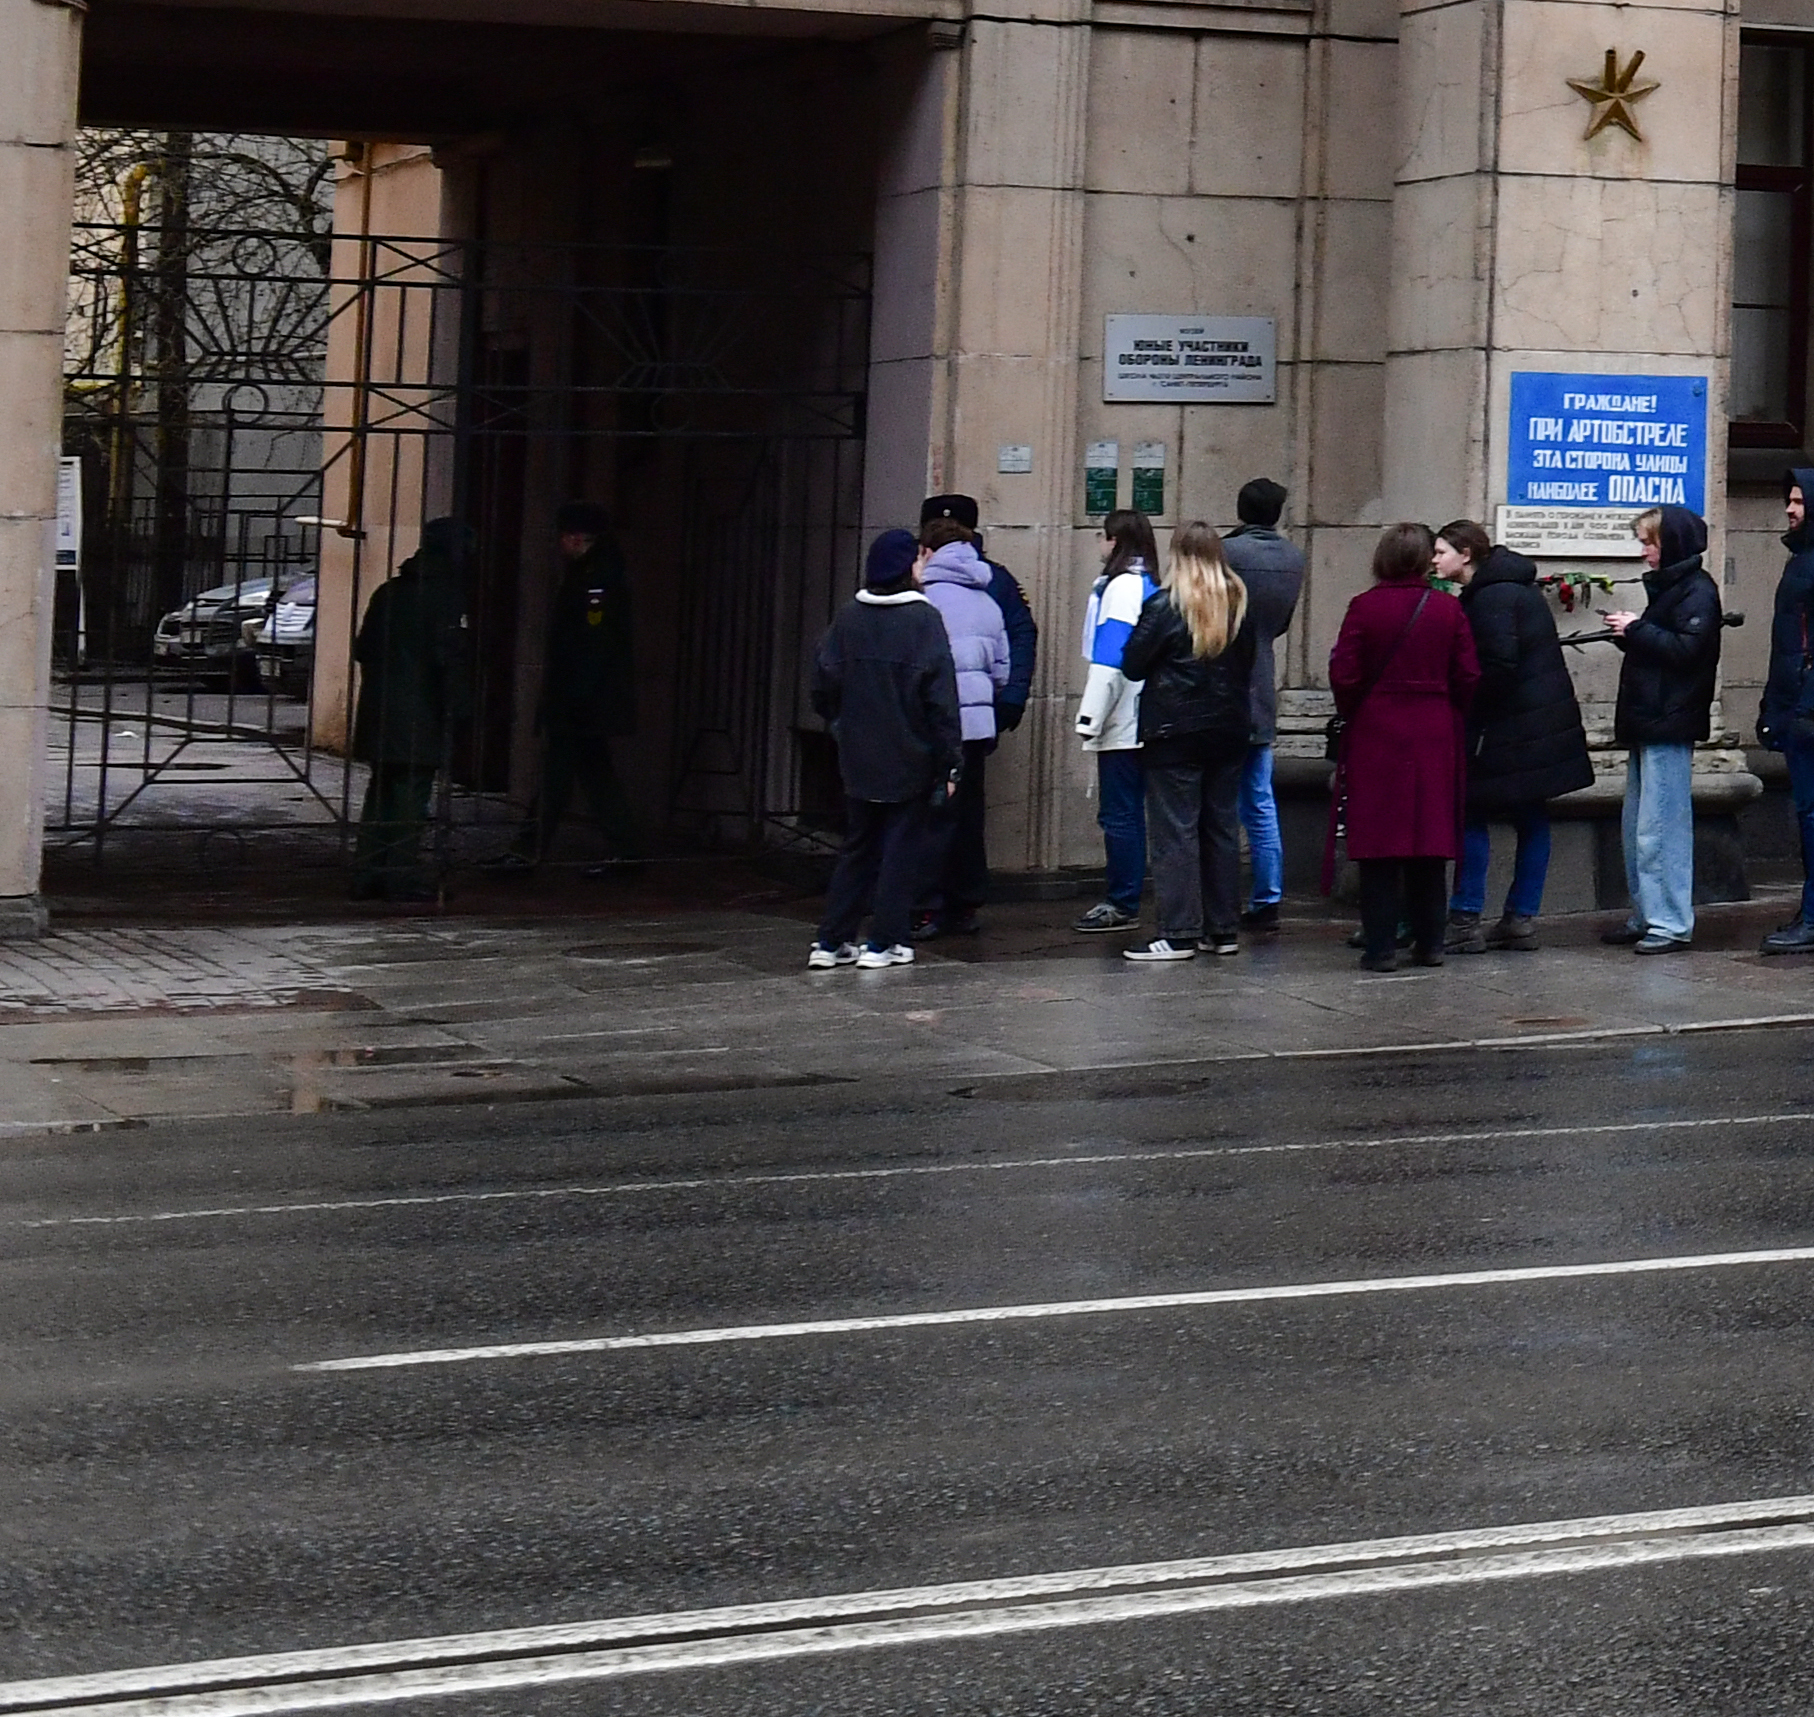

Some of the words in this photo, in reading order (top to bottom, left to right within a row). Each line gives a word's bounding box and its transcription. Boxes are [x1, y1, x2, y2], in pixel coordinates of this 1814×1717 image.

[1133, 340, 1173, 352] ЮНЫЕ
[1178, 340, 1249, 353] УЧАСТНИКИ
[1119, 354, 1180, 366] ОБОРОНЫ
[1184, 354, 1263, 368] ЛЕНИНГРАДА
[1563, 393, 1657, 413] ГРАЖДАНЕ!
[1529, 417, 1564, 442] ПРИ
[1567, 419, 1689, 447] АРТОБСТРЕЛЕ
[1533, 449, 1562, 469] ЭТА
[1565, 450, 1631, 471] СТОРОНА
[1635, 454, 1688, 474] УЛИЦЫ
[1527, 481, 1600, 501] НАИБОЛЕЕ
[1608, 474, 1685, 504] ОПАСНА
